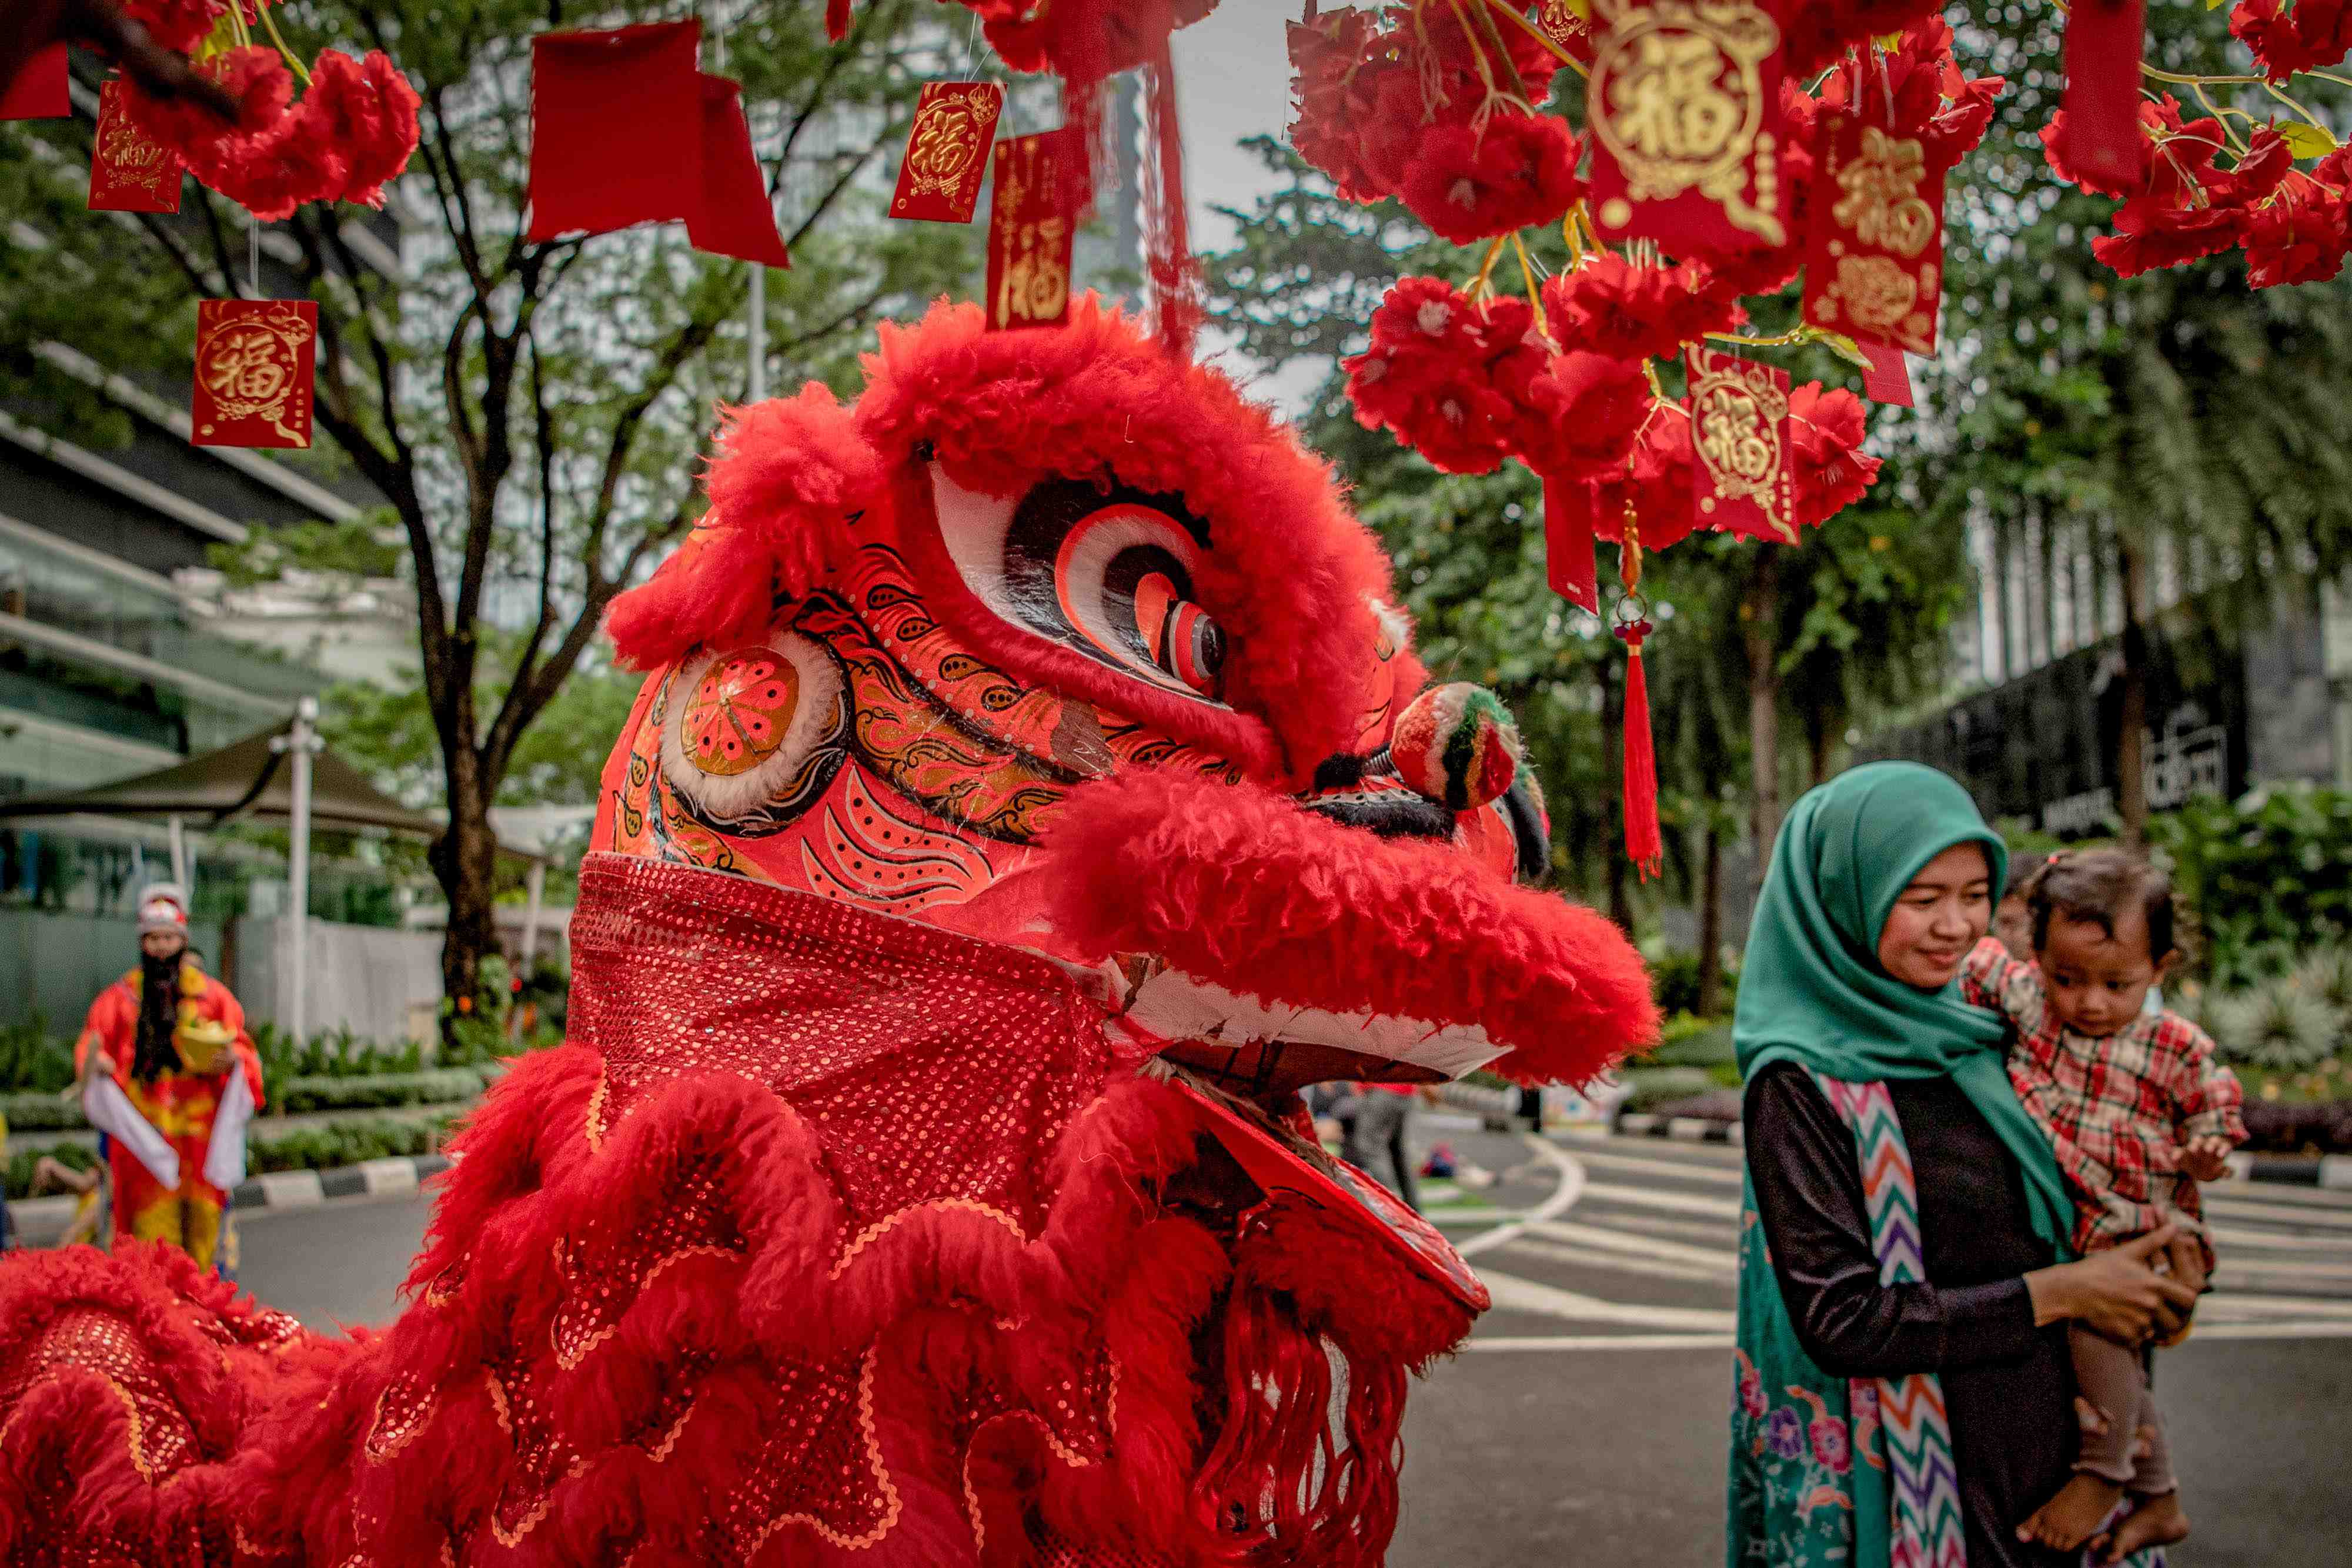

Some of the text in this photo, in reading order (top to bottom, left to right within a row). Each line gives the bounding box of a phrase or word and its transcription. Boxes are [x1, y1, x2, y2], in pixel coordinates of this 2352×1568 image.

[1606, 34, 1739, 158] 福
[912, 110, 969, 175] 福
[206, 330, 285, 398] 福
[1703, 387, 1769, 479] 福
